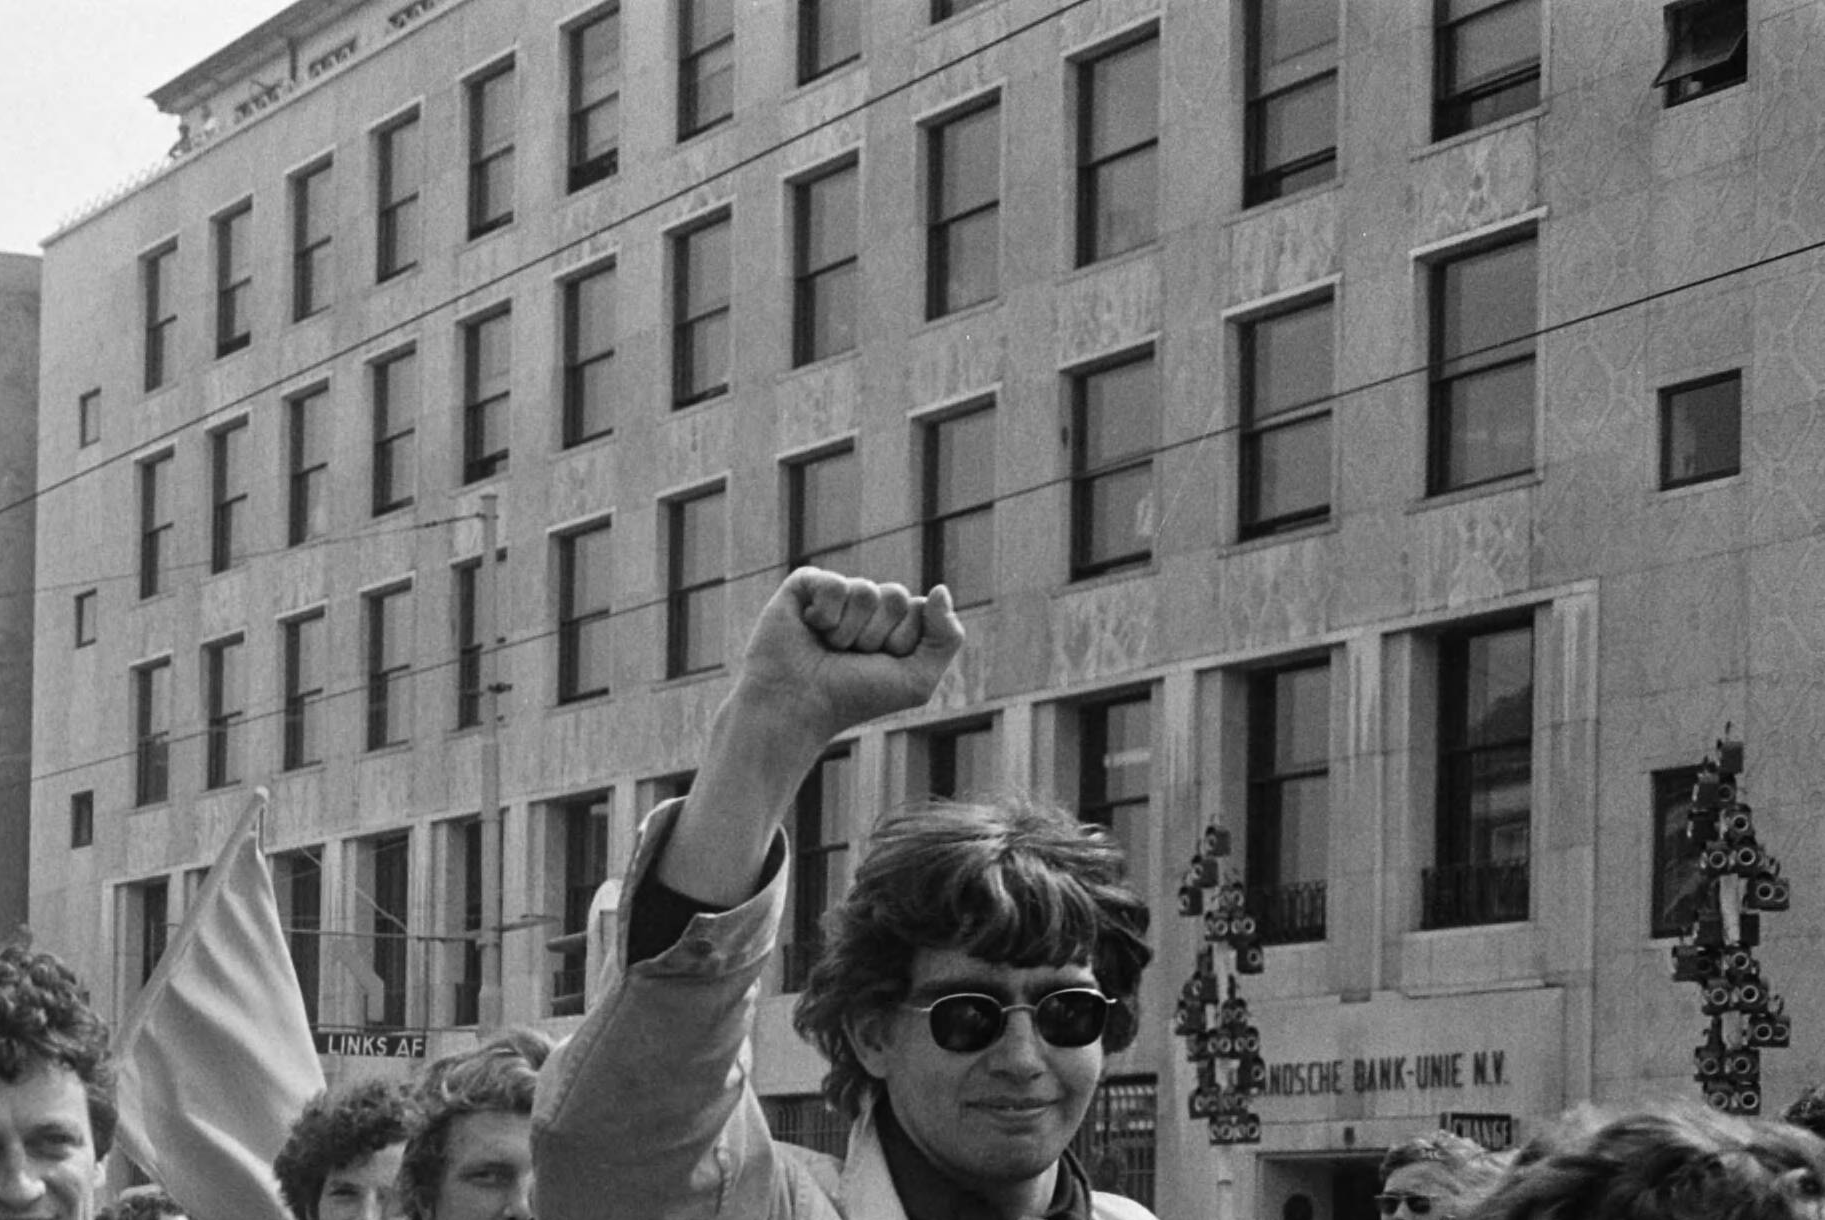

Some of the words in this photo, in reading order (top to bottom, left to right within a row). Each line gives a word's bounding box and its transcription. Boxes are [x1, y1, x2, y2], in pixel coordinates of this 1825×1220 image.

[327, 1034, 388, 1056] LINKS
[395, 1036, 424, 1057] AF
[1353, 1053, 1463, 1092] BANK-UNIE
[1473, 1050, 1509, 1086] N.V.
